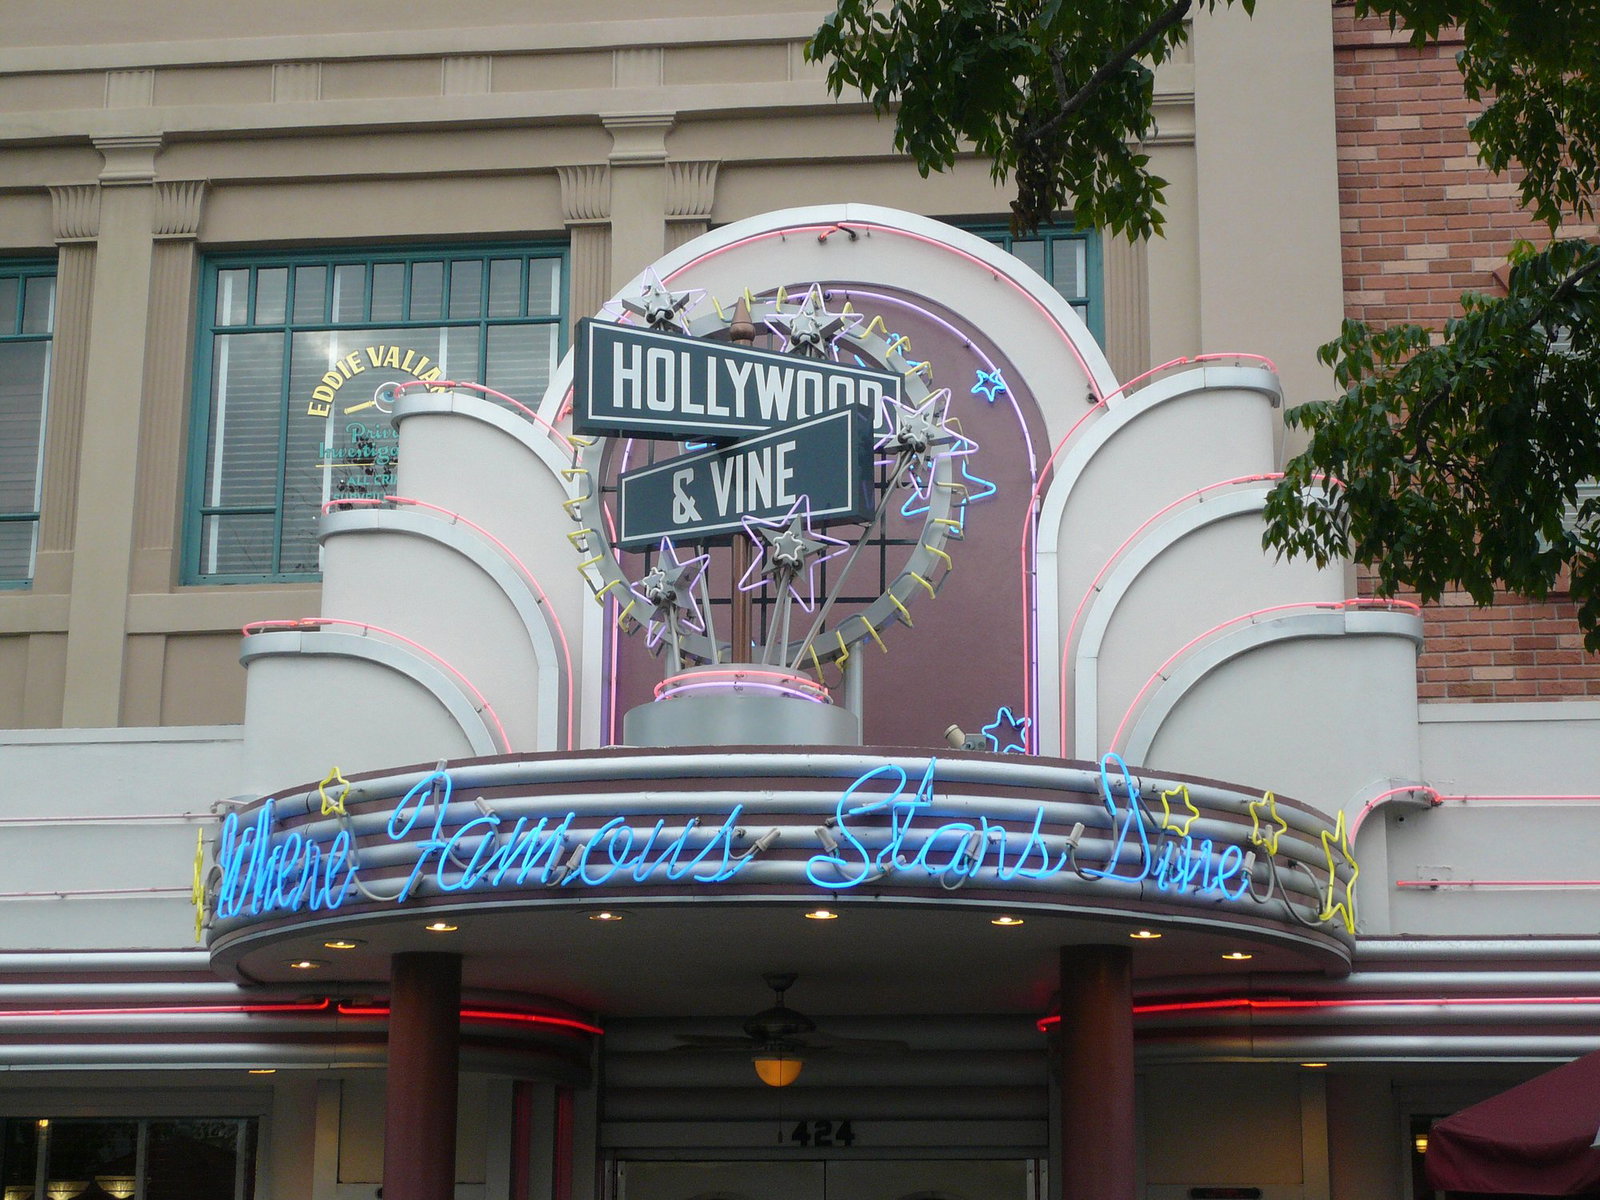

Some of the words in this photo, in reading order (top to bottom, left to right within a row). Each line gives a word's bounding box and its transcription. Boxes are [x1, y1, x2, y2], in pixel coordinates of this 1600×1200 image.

[307, 351, 366, 417] EDDIE
[366, 345, 453, 393] VALIA
[613, 341, 883, 429] HOLLYWOOD
[347, 475, 370, 486] ALL
[374, 474, 398, 486] CRI
[672, 467, 702, 524] &
[710, 440, 796, 517] VINE
[215, 798, 360, 919] Where
[388, 769, 754, 904] Famous
[806, 756, 1067, 888] Stars
[1080, 751, 1250, 901] Dine
[791, 1119, 855, 1147] 424
